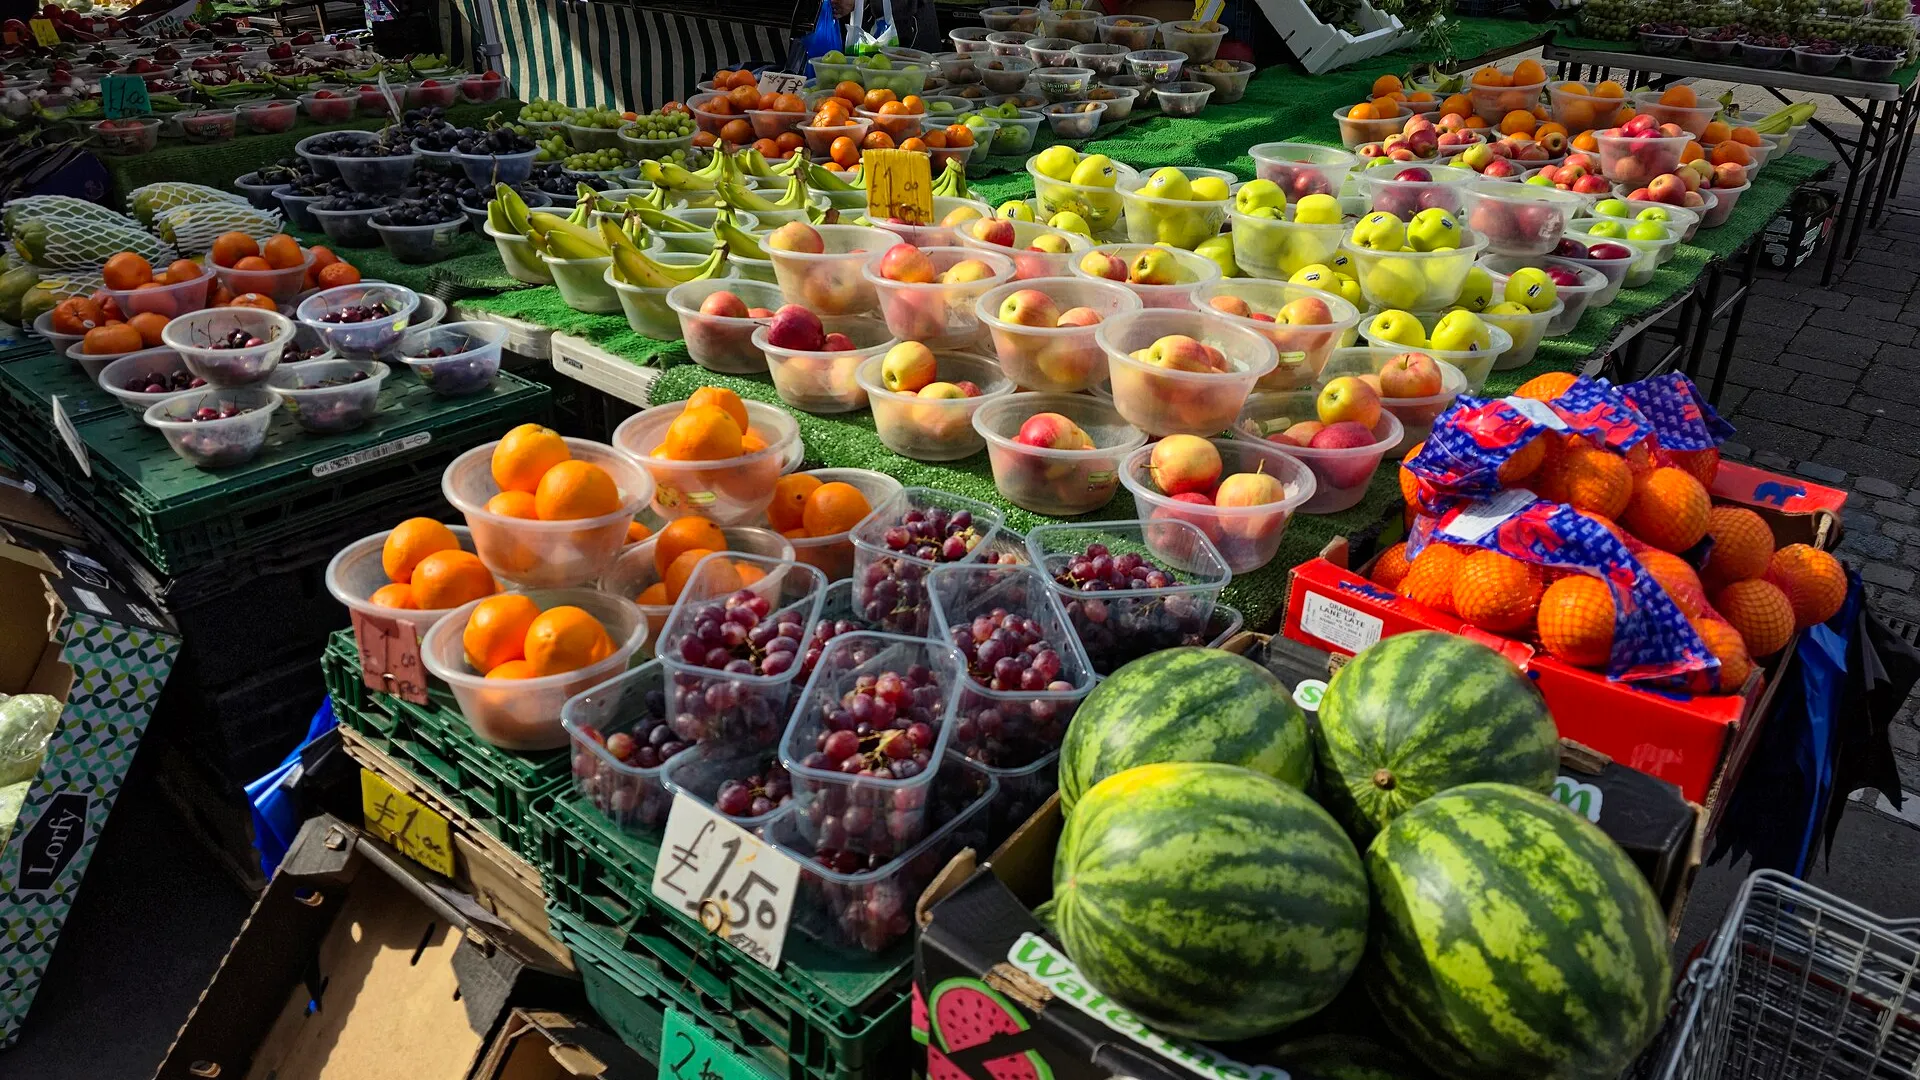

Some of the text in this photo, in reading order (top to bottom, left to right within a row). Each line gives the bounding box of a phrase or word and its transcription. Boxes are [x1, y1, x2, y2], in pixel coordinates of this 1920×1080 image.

[1319, 605, 1340, 618] LANE
[1344, 616, 1366, 629] LATE
[1329, 602, 1356, 618] ORANGE
[27, 808, 83, 877] Lorfy
[661, 819, 779, 930] £1.50
